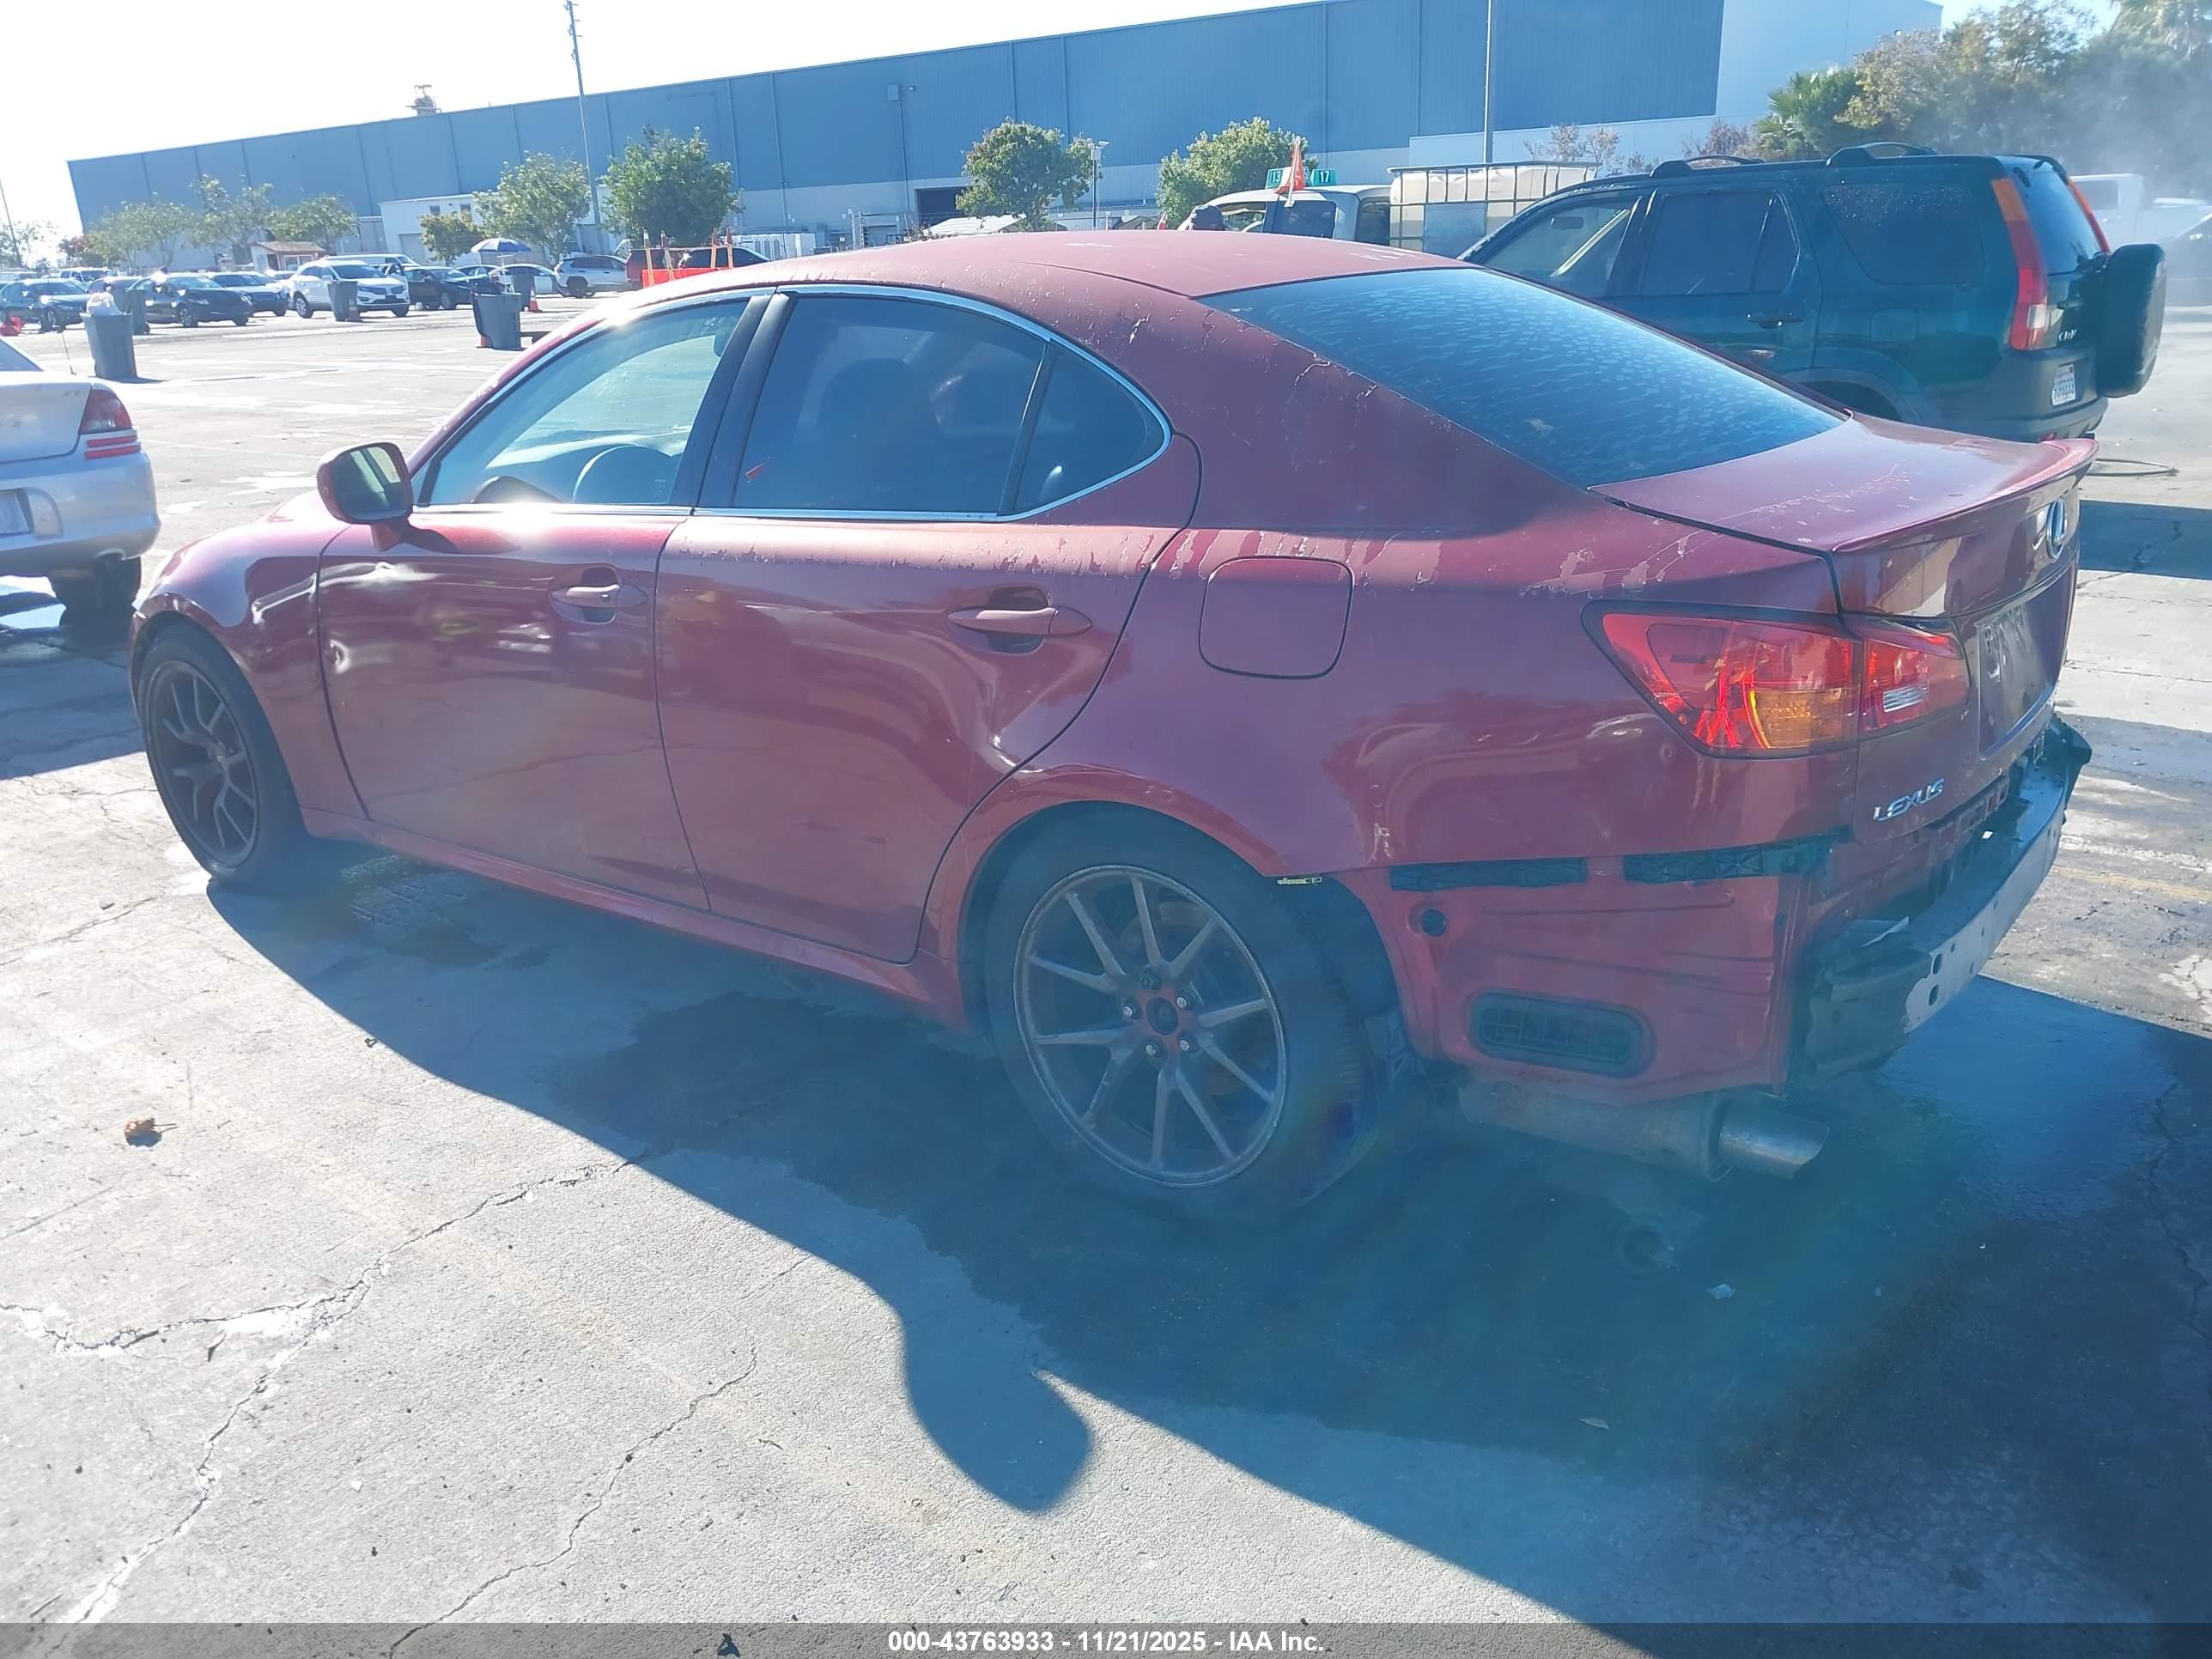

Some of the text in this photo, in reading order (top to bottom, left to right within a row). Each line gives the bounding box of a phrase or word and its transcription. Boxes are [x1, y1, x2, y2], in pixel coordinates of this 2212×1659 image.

[1272, 170, 1281, 183] 13
[1320, 170, 1330, 183] 17
[1873, 777, 1945, 822] LEXUS
